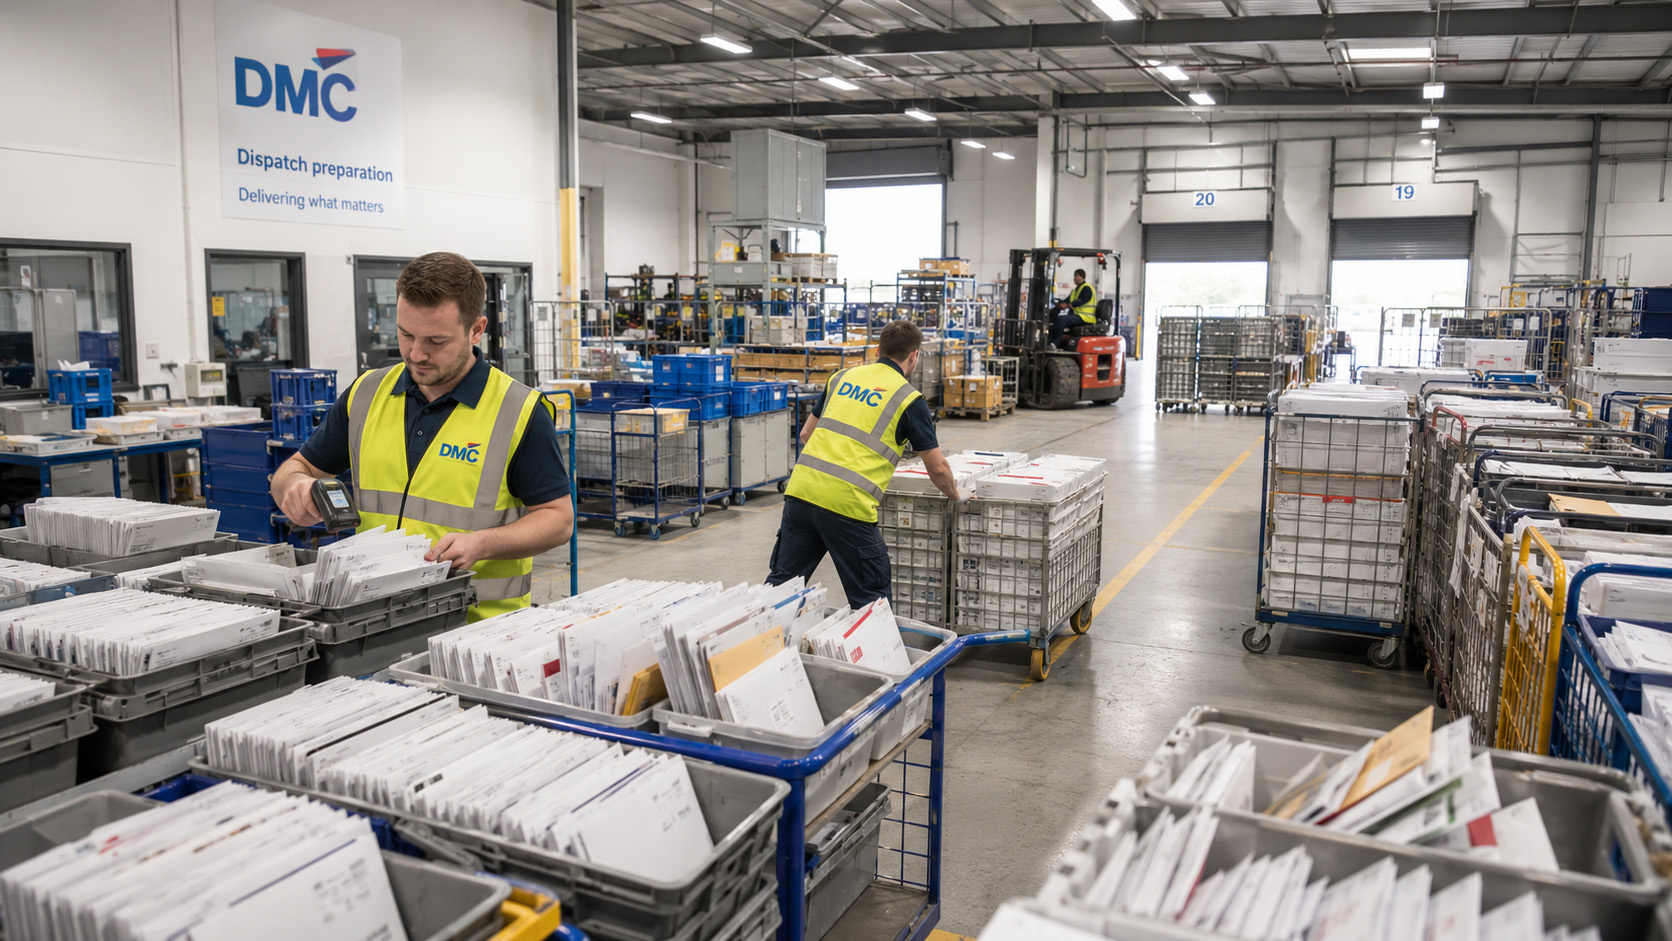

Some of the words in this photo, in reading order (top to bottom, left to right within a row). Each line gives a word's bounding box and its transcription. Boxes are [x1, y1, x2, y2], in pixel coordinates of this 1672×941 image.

[234, 56, 358, 123] DMC
[237, 147, 308, 172] Dispatch
[312, 160, 393, 182] preparation
[238, 187, 305, 210] Delivering
[308, 194, 338, 210] what
[341, 199, 384, 213] matters
[1195, 192, 1215, 206] 20
[1395, 185, 1415, 200] 19
[837, 382, 883, 407] DMC
[438, 443, 480, 463] DMC
